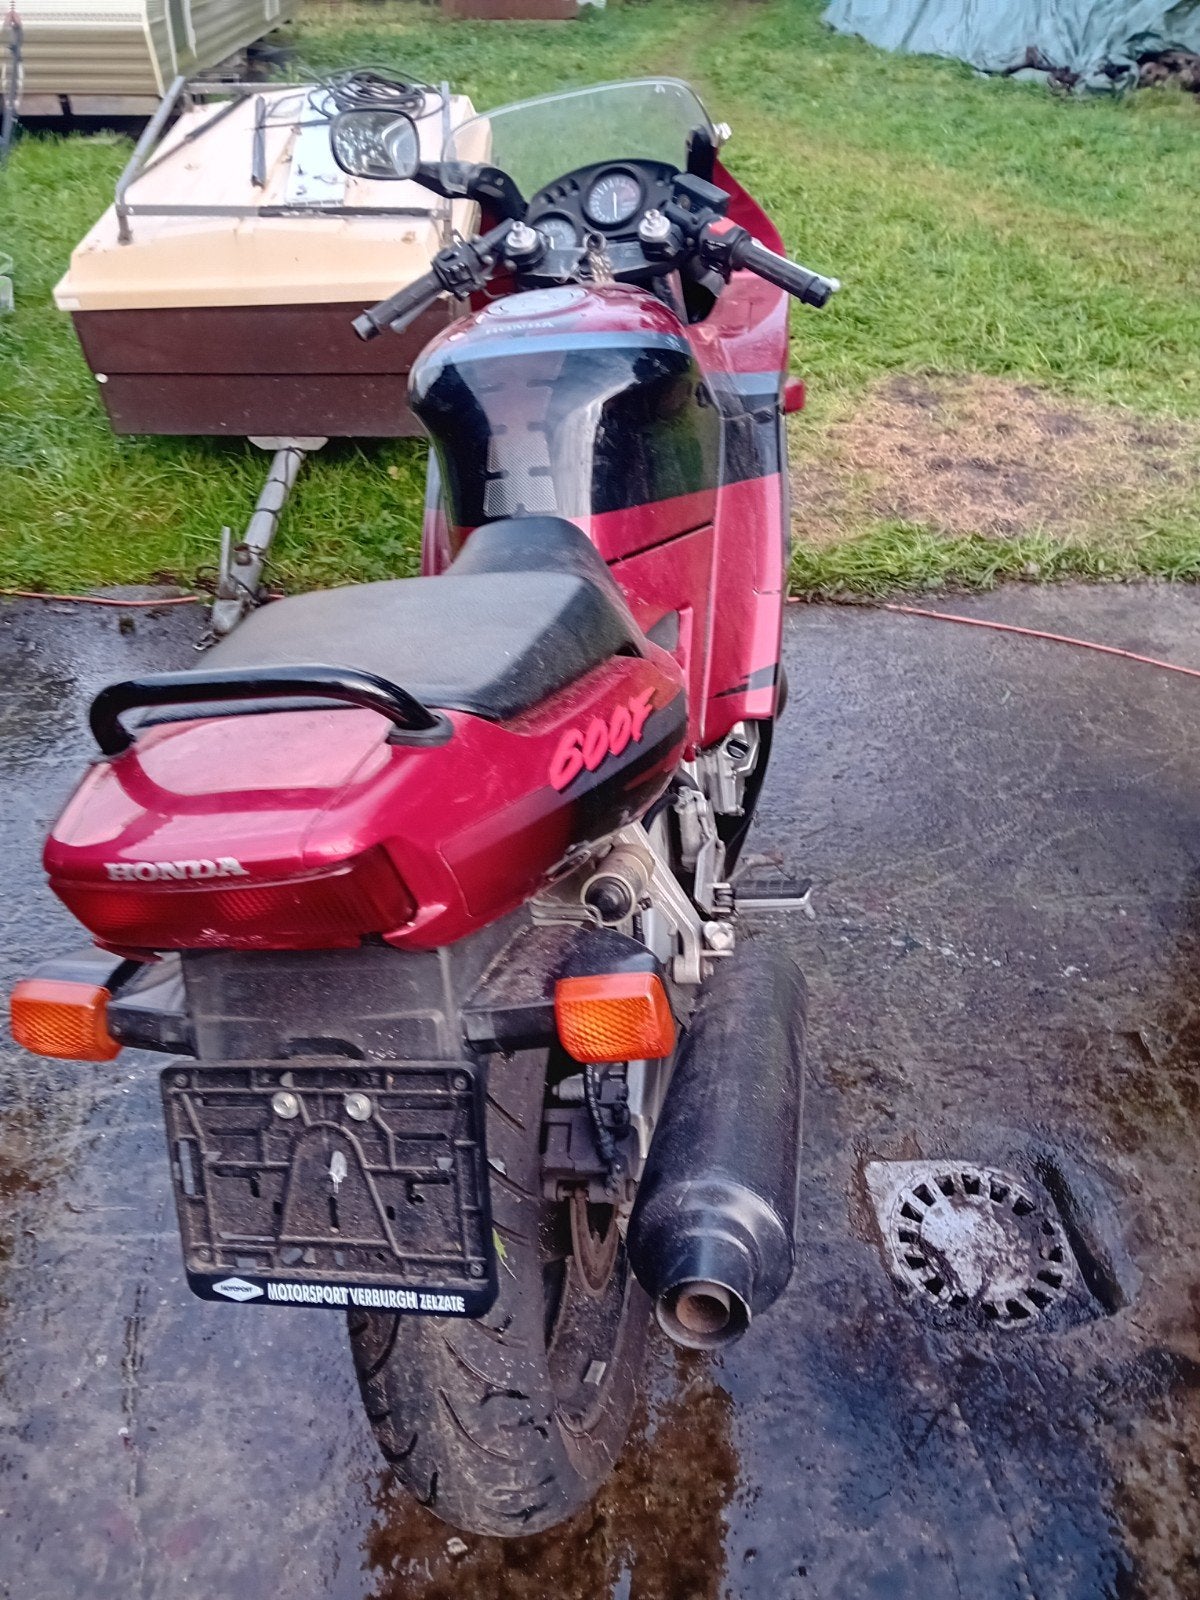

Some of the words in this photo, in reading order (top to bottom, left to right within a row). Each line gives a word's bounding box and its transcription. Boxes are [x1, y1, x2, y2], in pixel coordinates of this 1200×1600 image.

[549, 686, 656, 791] 600F
[103, 857, 249, 881] HONDA
[267, 1282, 349, 1305] MOTORSPORT
[349, 1287, 418, 1309] VERBURGH
[419, 1294, 465, 1312] ZELZATE
